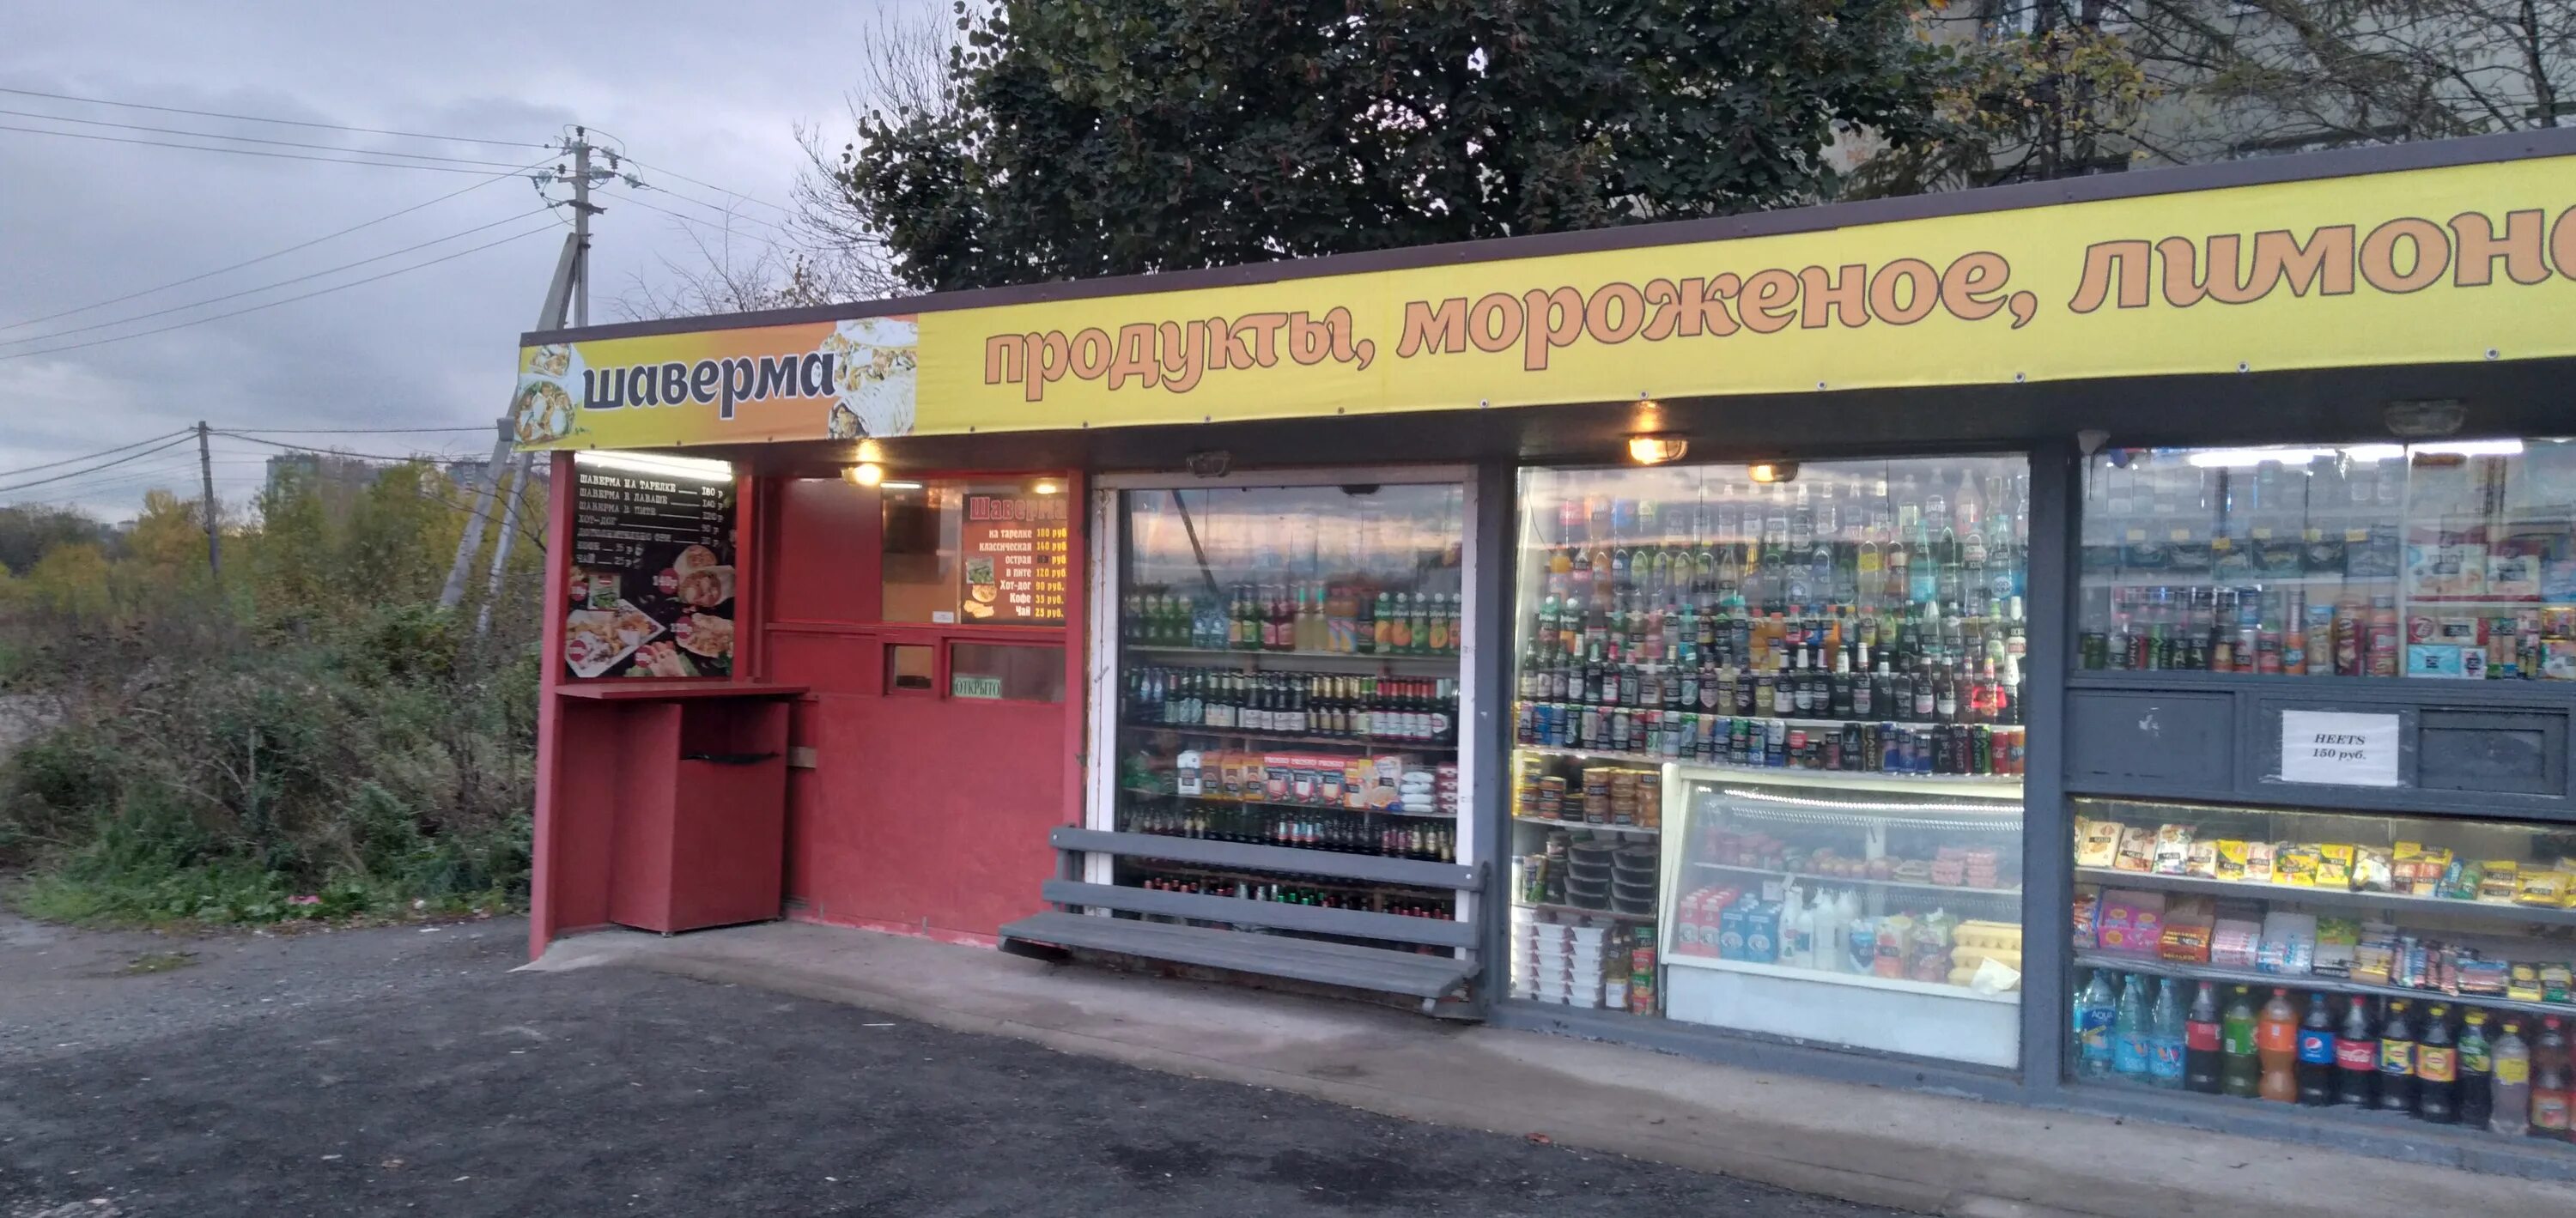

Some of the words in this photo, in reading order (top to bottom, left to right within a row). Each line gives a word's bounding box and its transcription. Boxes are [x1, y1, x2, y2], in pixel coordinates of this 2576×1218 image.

[985, 306, 1376, 403] продукты,
[1396, 251, 2038, 372] мороженое,
[583, 352, 837, 421] шаверма
[580, 474, 621, 487] ШАВЕРМА
[623, 478, 637, 488] НА
[639, 480, 677, 493] ТАРЕЛКЕ
[702, 486, 716, 496] 180
[579, 488, 620, 500] ШАВЕРМА
[623, 492, 630, 501] В
[634, 493, 668, 505] ЛАВАШЕ
[579, 500, 620, 512] ШАВЕРМА
[969, 496, 1067, 522] Шаверма
[988, 529, 999, 538] на
[1000, 529, 1032, 539] тарелке
[979, 542, 1032, 552] классическая
[1036, 567, 1049, 578] 120
[999, 579, 1031, 591] Хот-дог
[1010, 592, 1031, 604] Кофе
[955, 680, 1000, 697] ОТКРЫТО
[2314, 733, 2366, 746] HEETS
[2312, 748, 2336, 758] 150
[2338, 748, 2367, 761] руб.
[2091, 1009, 2114, 1021] AQUA
